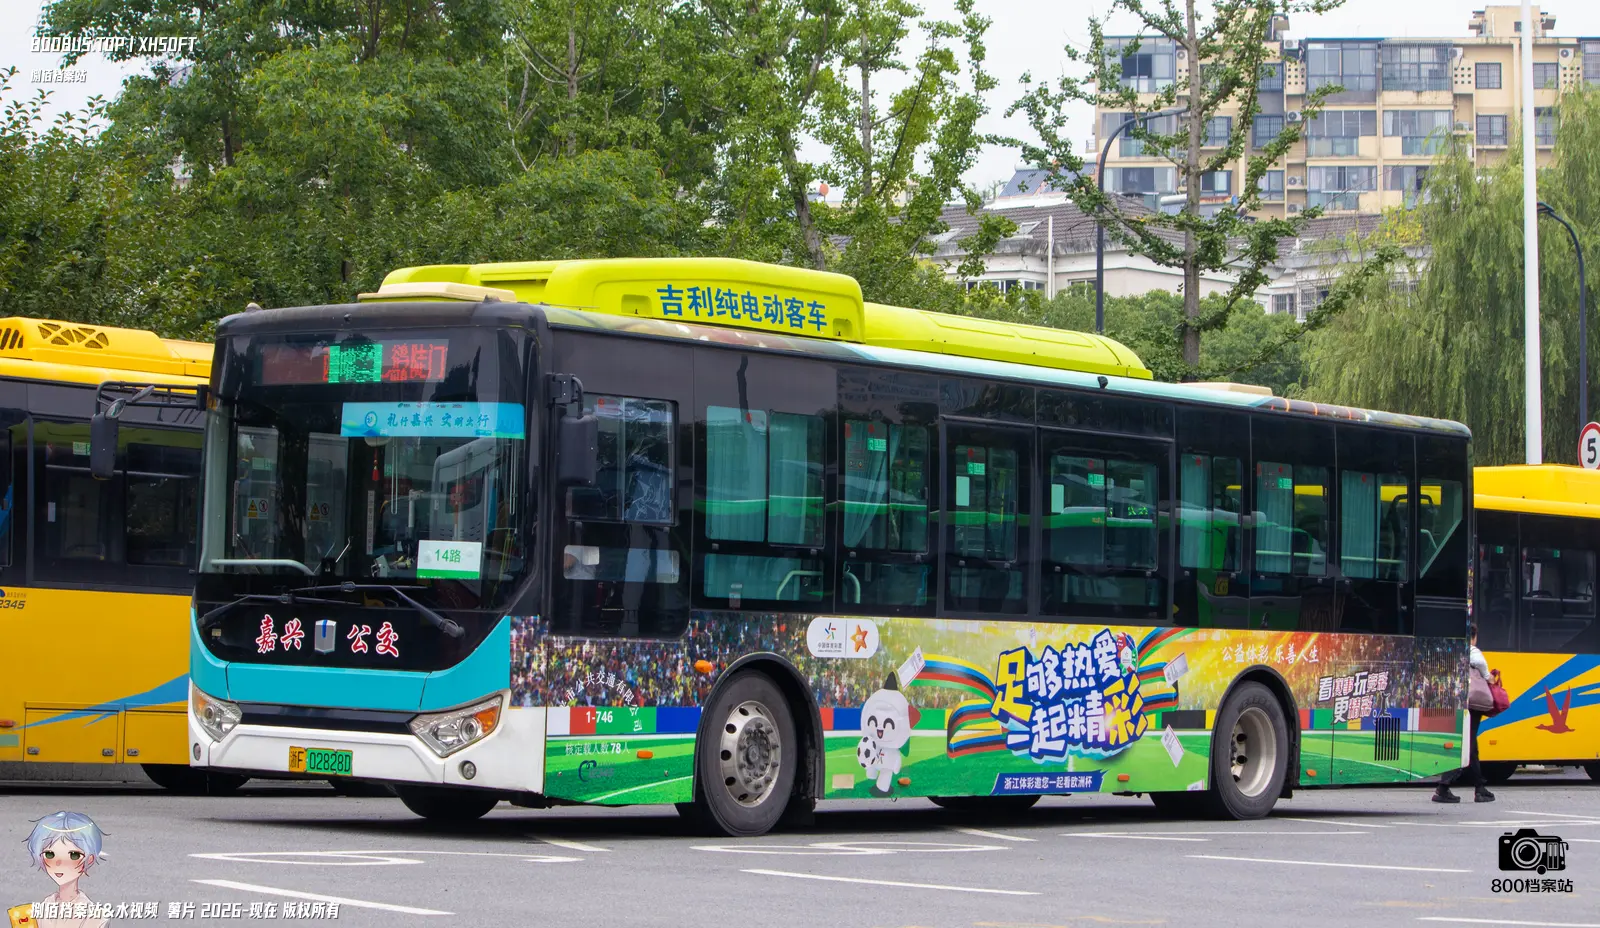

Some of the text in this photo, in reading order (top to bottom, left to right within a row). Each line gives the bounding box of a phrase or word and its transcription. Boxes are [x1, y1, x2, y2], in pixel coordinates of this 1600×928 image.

[656, 284, 828, 332] 吉利纯电动客车
[1587, 438, 1597, 464] 5
[434, 548, 462, 563] 14路
[256, 614, 400, 658] 嘉兴 公交
[991, 629, 1121, 722] 足够热爱
[586, 711, 614, 724] 1-746
[1006, 673, 1148, 753] 一起精彩
[1004, 775, 1093, 790] 浙江体彩邀您一起看欧洲杯
